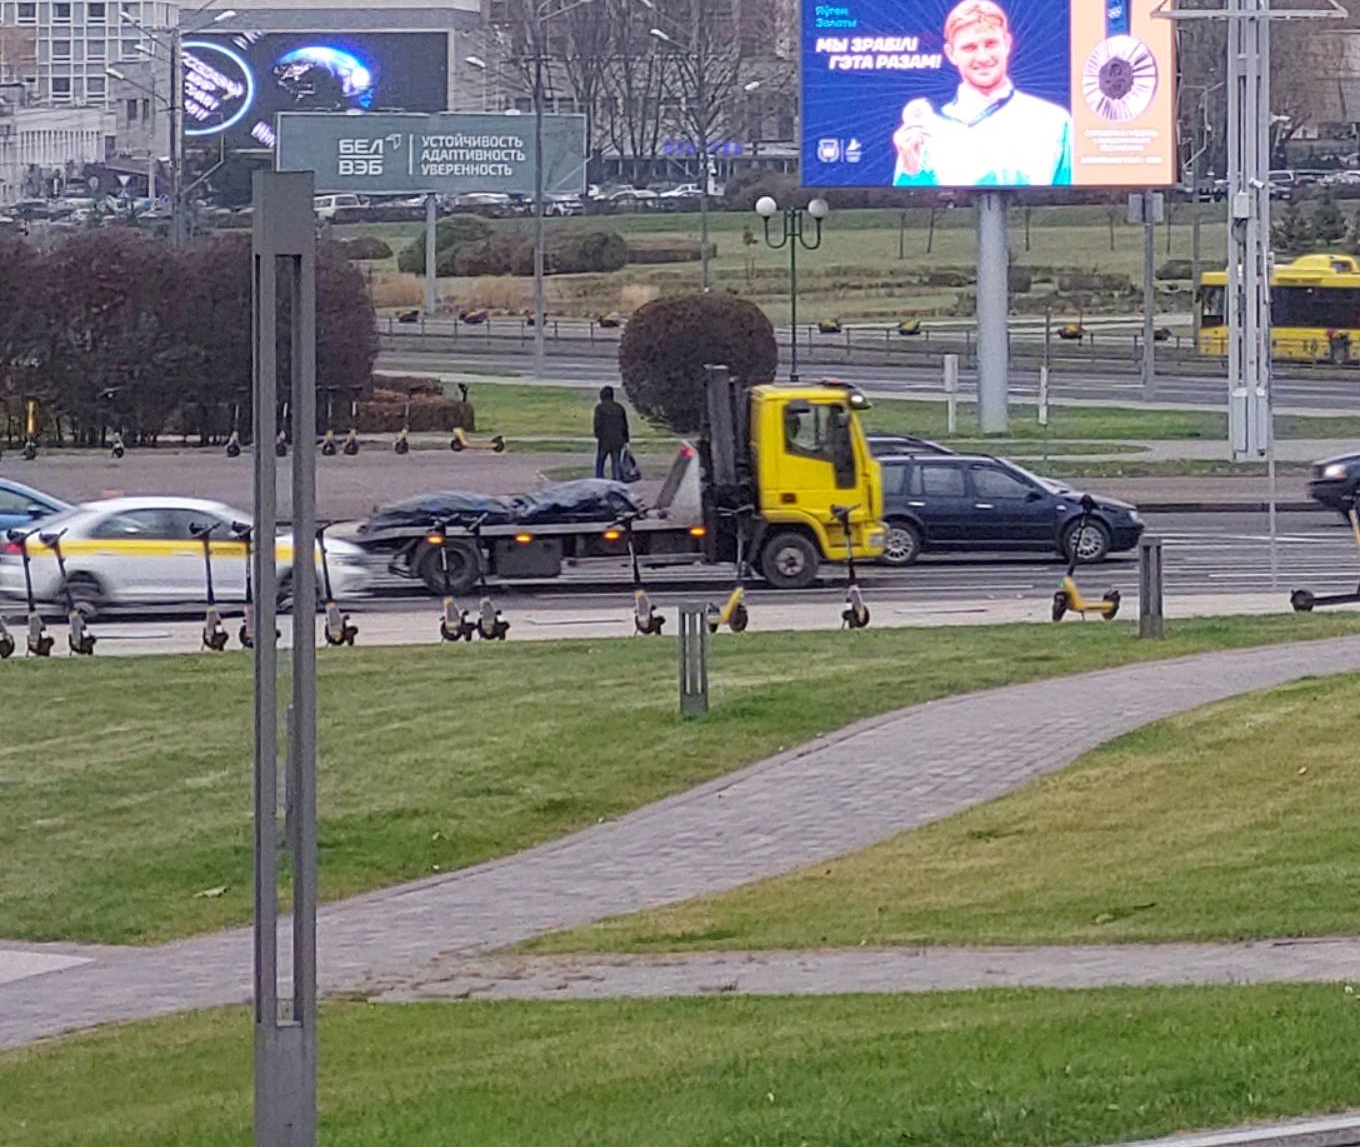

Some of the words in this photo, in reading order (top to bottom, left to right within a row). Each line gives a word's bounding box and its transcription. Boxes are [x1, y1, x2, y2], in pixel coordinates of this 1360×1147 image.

[816, 38, 848, 52] МЫ
[851, 37, 918, 52] ЗРАБІЛІ
[829, 55, 873, 69] ГЭТА
[876, 54, 941, 69] РАЗАМ!
[339, 139, 383, 154] БЕЛ
[421, 133, 523, 148] УСТОЙЧИВОСТЬ
[421, 149, 525, 163] АДАПТИВНОСТЬ
[339, 160, 383, 175] ВЭБ
[421, 163, 512, 176] УВЕРЕННОСТЬ
